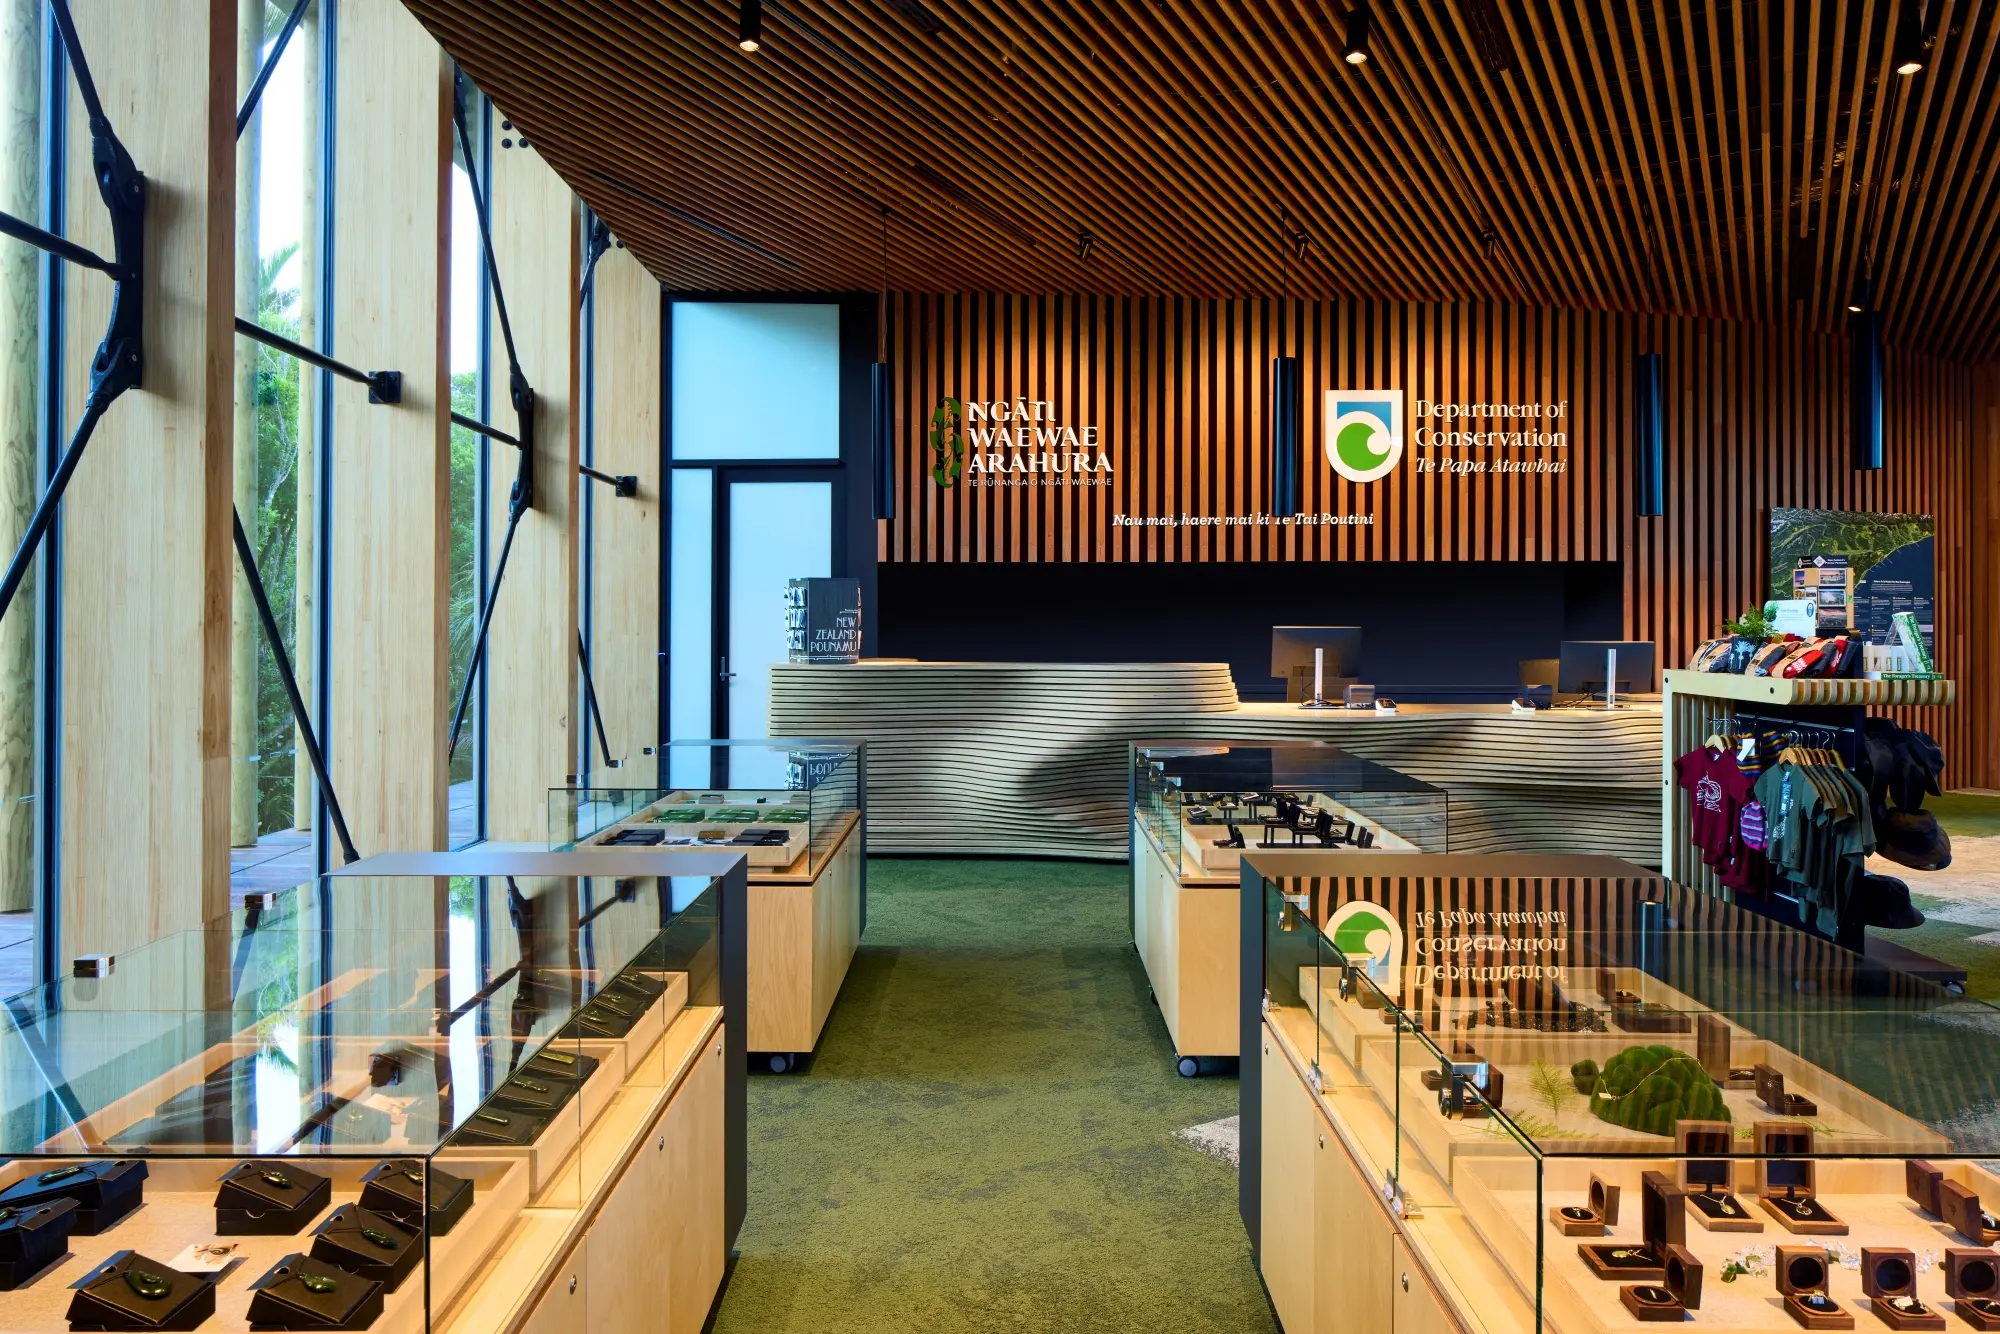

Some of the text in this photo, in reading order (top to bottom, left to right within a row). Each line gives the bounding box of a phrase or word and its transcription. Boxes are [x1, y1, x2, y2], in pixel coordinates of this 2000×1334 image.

[965, 396, 1056, 422] NGĀTI
[1415, 399, 1568, 423] Department of
[966, 426, 1099, 448] WAEWAE
[1414, 427, 1568, 447] Conservation
[967, 452, 1114, 473] ARAHURA
[1415, 457, 1568, 477] Te Papa Atawhai
[967, 476, 1112, 487] TE RŪNANGA O NGĀTI WAEWAE
[1112, 514, 1143, 526] Nau
[1146, 514, 1179, 528] mai,
[1181, 513, 1222, 525] haere
[1225, 513, 1253, 525] mai
[1256, 512, 1270, 525] ki
[1295, 513, 1318, 525] Tai
[1320, 512, 1374, 525] Poutini
[836, 616, 856, 627] NEW
[815, 629, 857, 640] ZEALAND
[810, 641, 857, 652] POUNAMU
